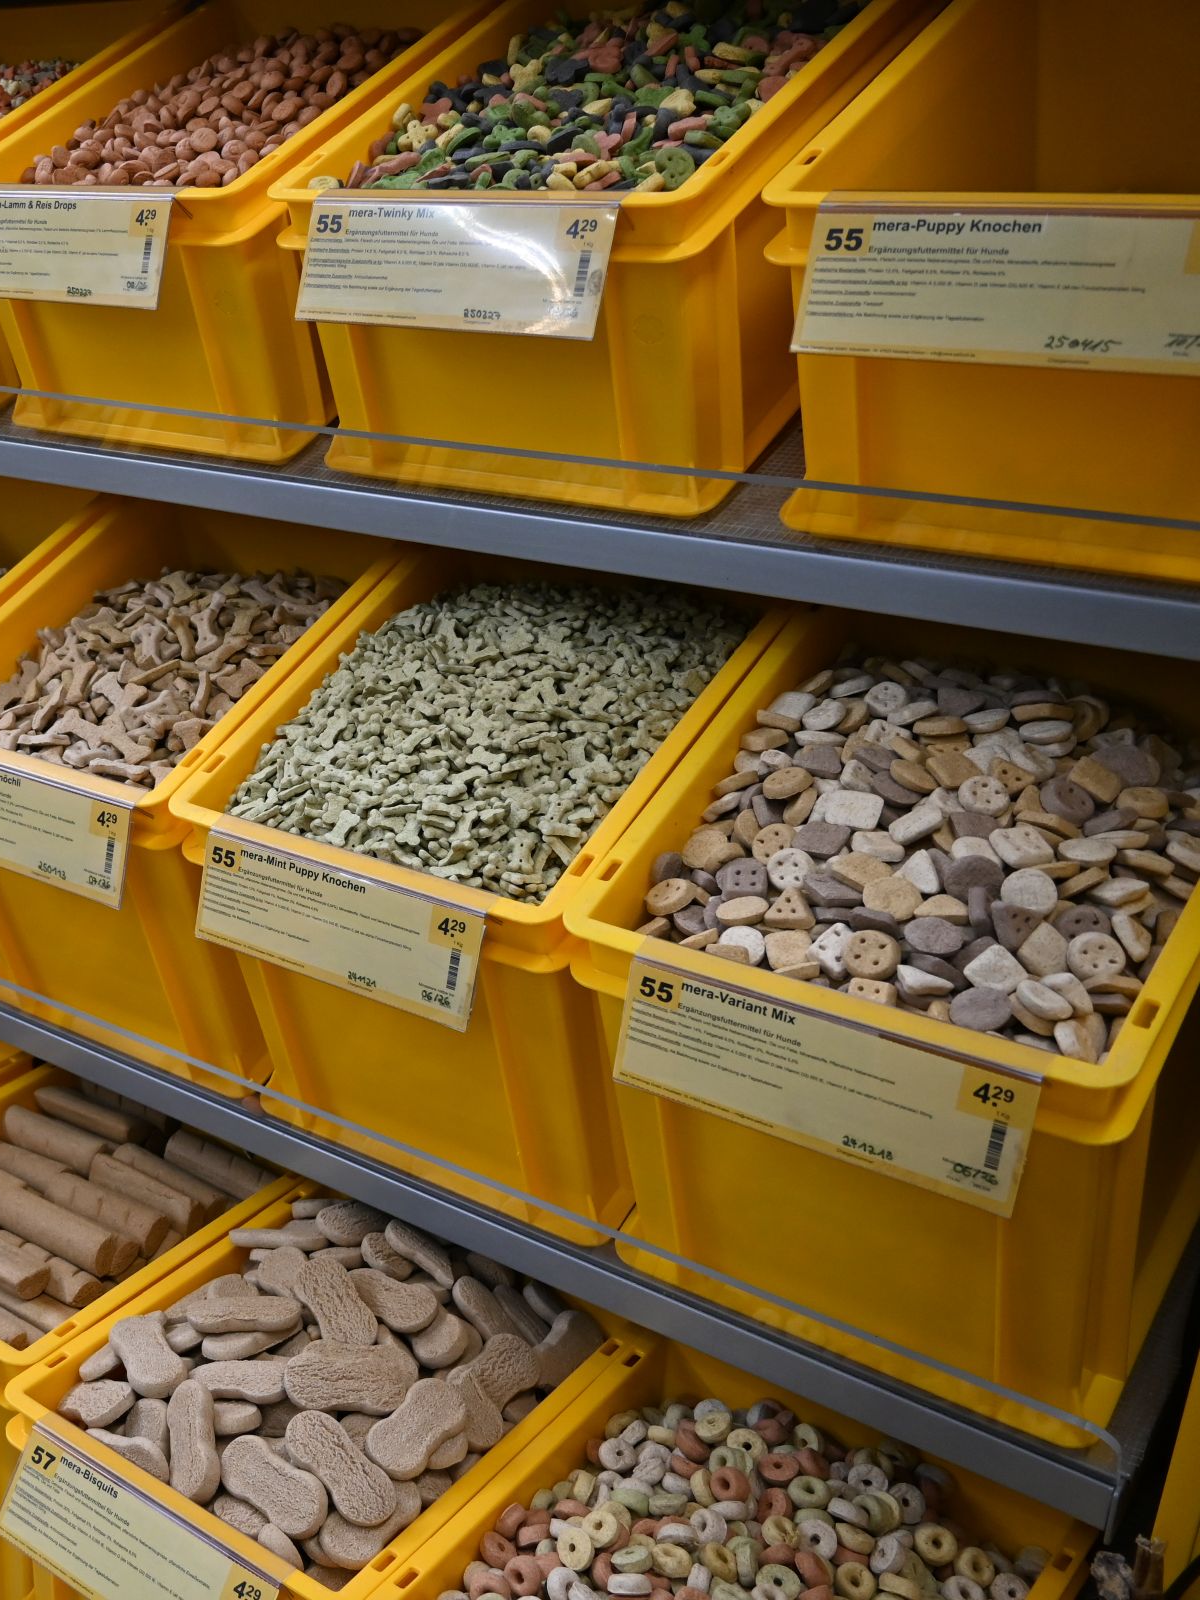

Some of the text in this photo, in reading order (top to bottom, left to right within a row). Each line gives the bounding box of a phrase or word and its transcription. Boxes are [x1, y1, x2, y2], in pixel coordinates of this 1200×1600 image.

[27, 200, 34, 209] &
[35, 200, 52, 210] Reis
[53, 201, 77, 212] Drops
[348, 207, 434, 220] mera-Twinky Mix
[135, 209, 157, 226] 4.29
[315, 214, 343, 233] 55
[872, 219, 1042, 235] mera-Puppy Knochen
[566, 219, 598, 239] 4.29
[824, 228, 864, 251] 55
[966, 247, 978, 255] für
[980, 247, 1009, 255] Hunde
[96, 810, 118, 828] 4.29
[211, 845, 236, 868] 55
[240, 849, 287, 870] mera-Mint
[288, 861, 320, 881] Puppy
[321, 872, 366, 894] Knochen
[296, 884, 305, 892] für
[437, 917, 466, 938] 4.29
[639, 975, 674, 1003] 55
[681, 982, 796, 1025] mera-Variant Mix
[677, 1002, 802, 1047] Ergänzungsfuttermittel für Hunde
[972, 1082, 1015, 1108] 4.29
[31, 1445, 57, 1471] 57
[59, 1455, 119, 1499] mera-Bisquits
[106, 1507, 114, 1516] für
